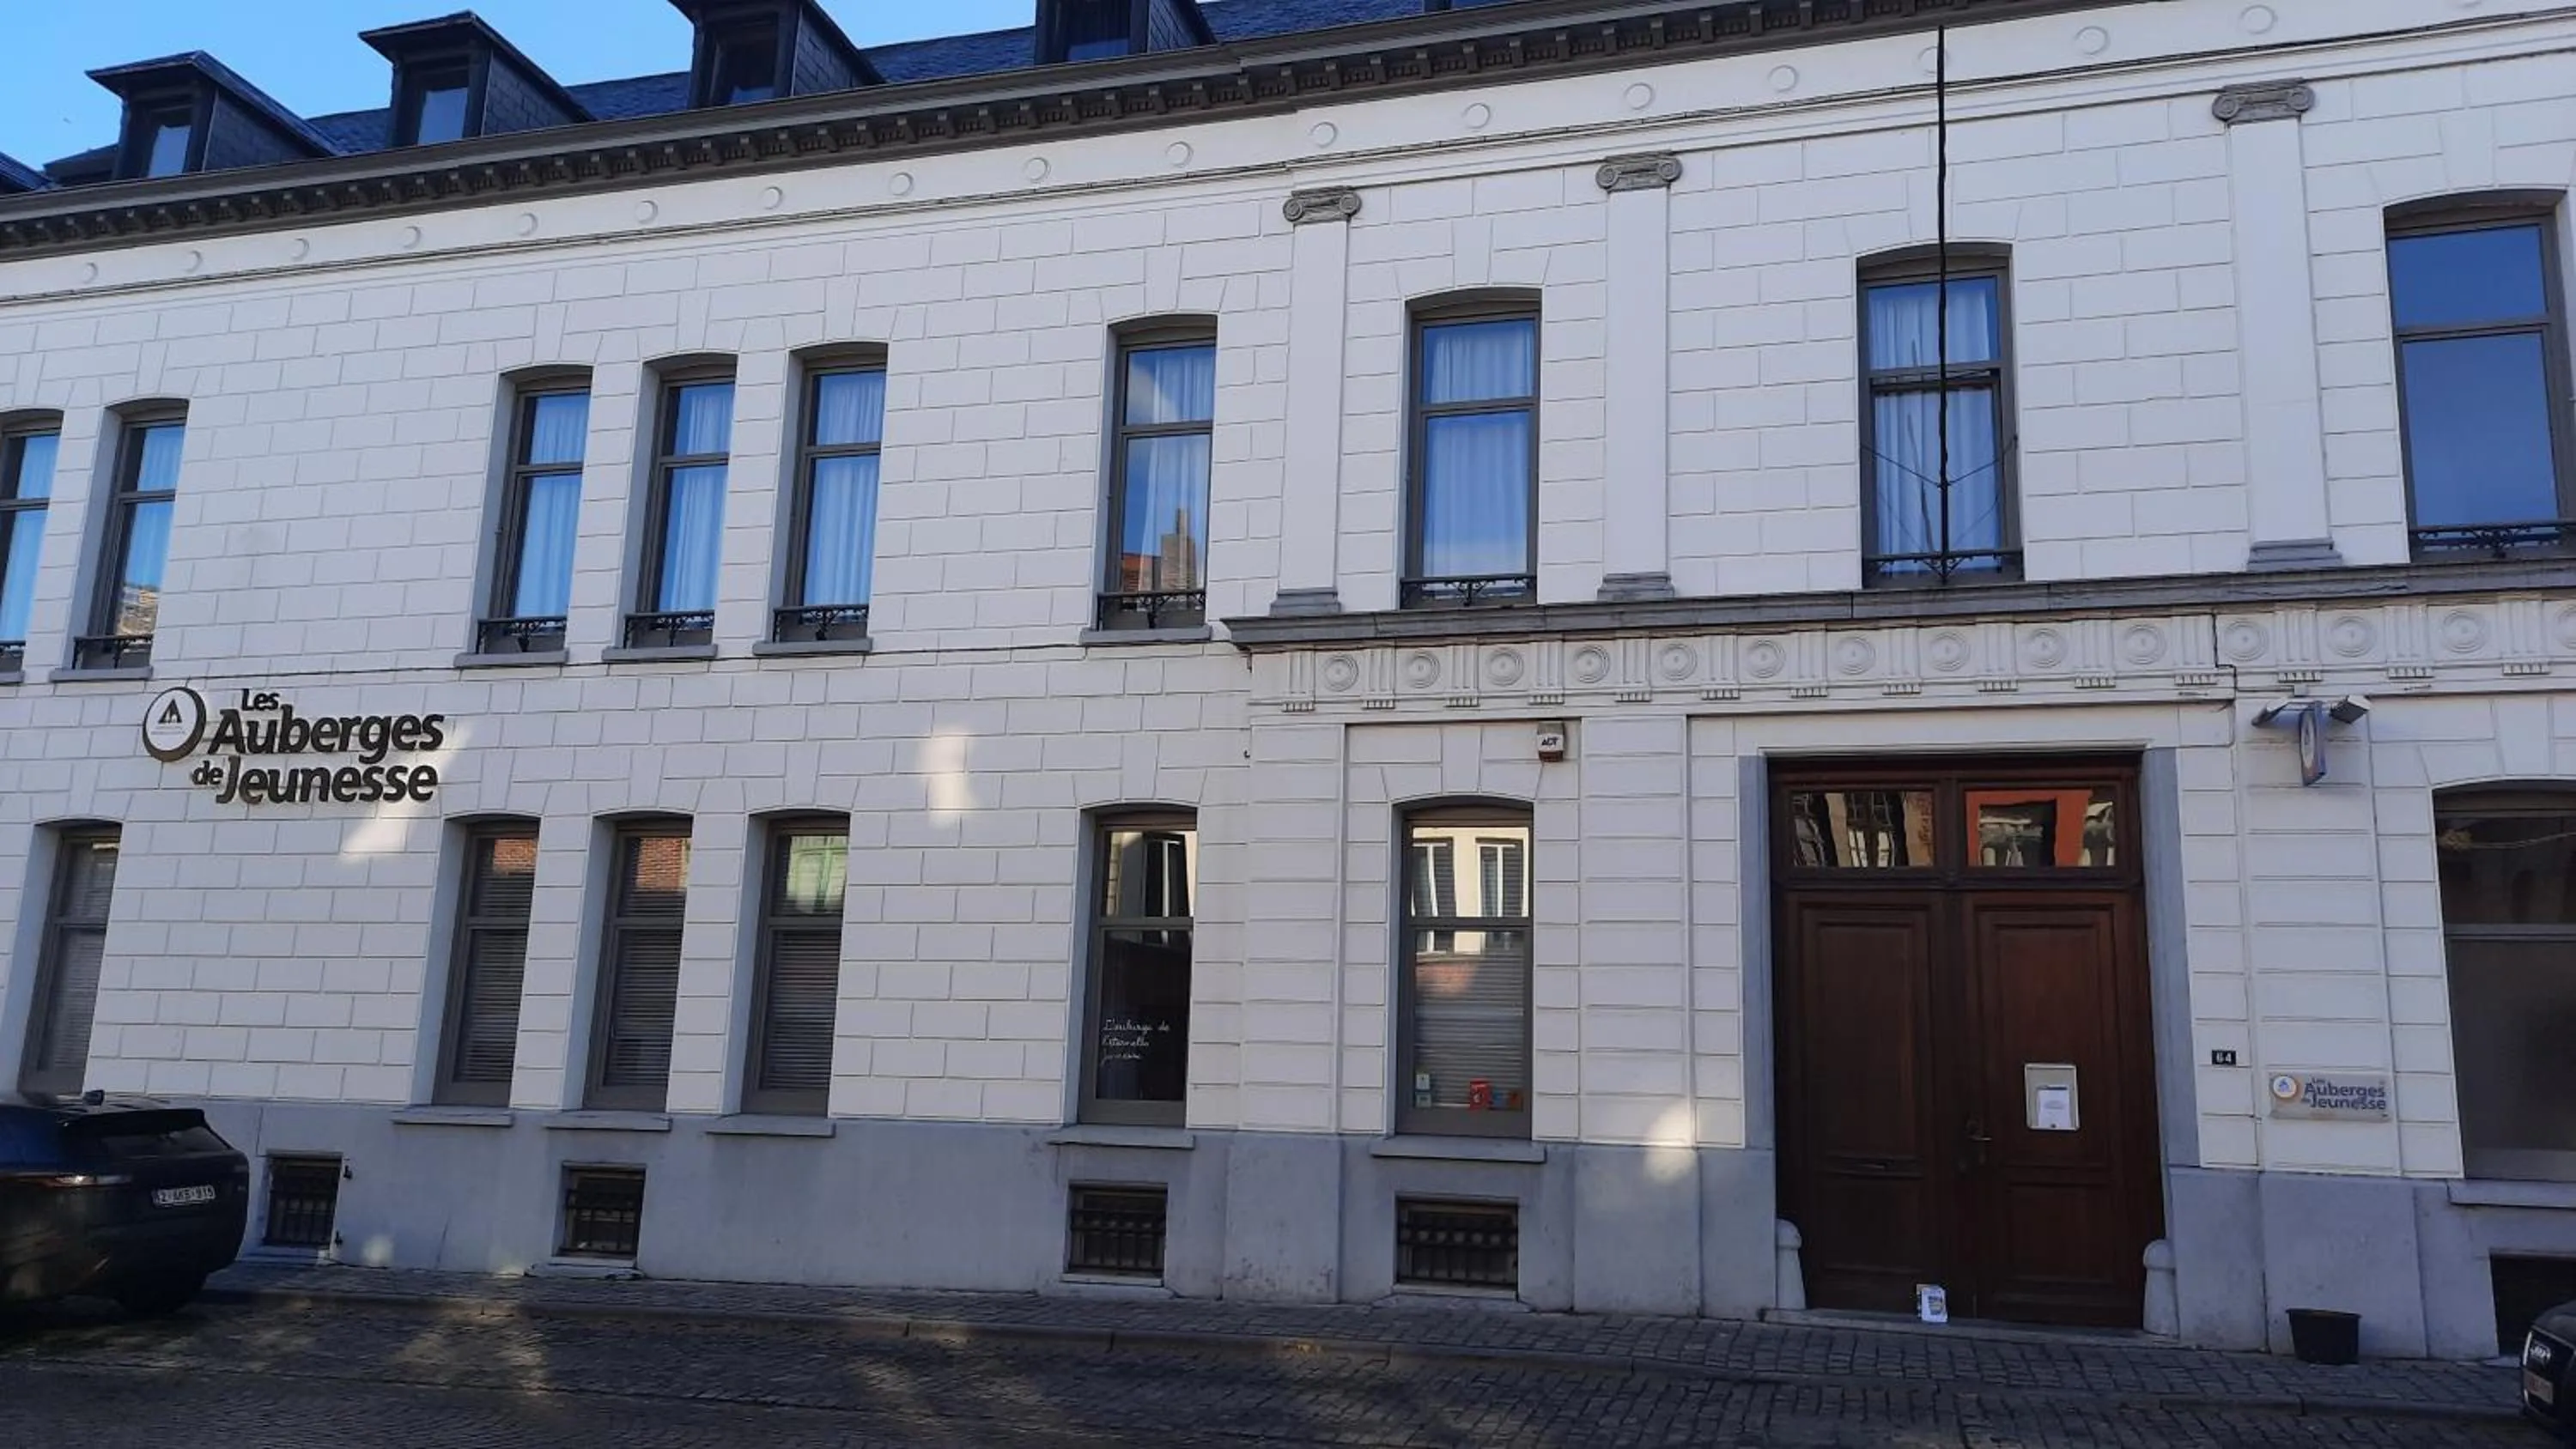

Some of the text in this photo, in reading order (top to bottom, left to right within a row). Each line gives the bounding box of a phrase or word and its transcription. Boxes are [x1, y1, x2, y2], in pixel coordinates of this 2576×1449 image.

[240, 688, 280, 712] Les
[208, 704, 445, 765] Auberges
[192, 755, 439, 804] de Jeunesse
[2304, 1081, 2385, 1100] Auberges
[2310, 1093, 2387, 1110] Jeunesse
